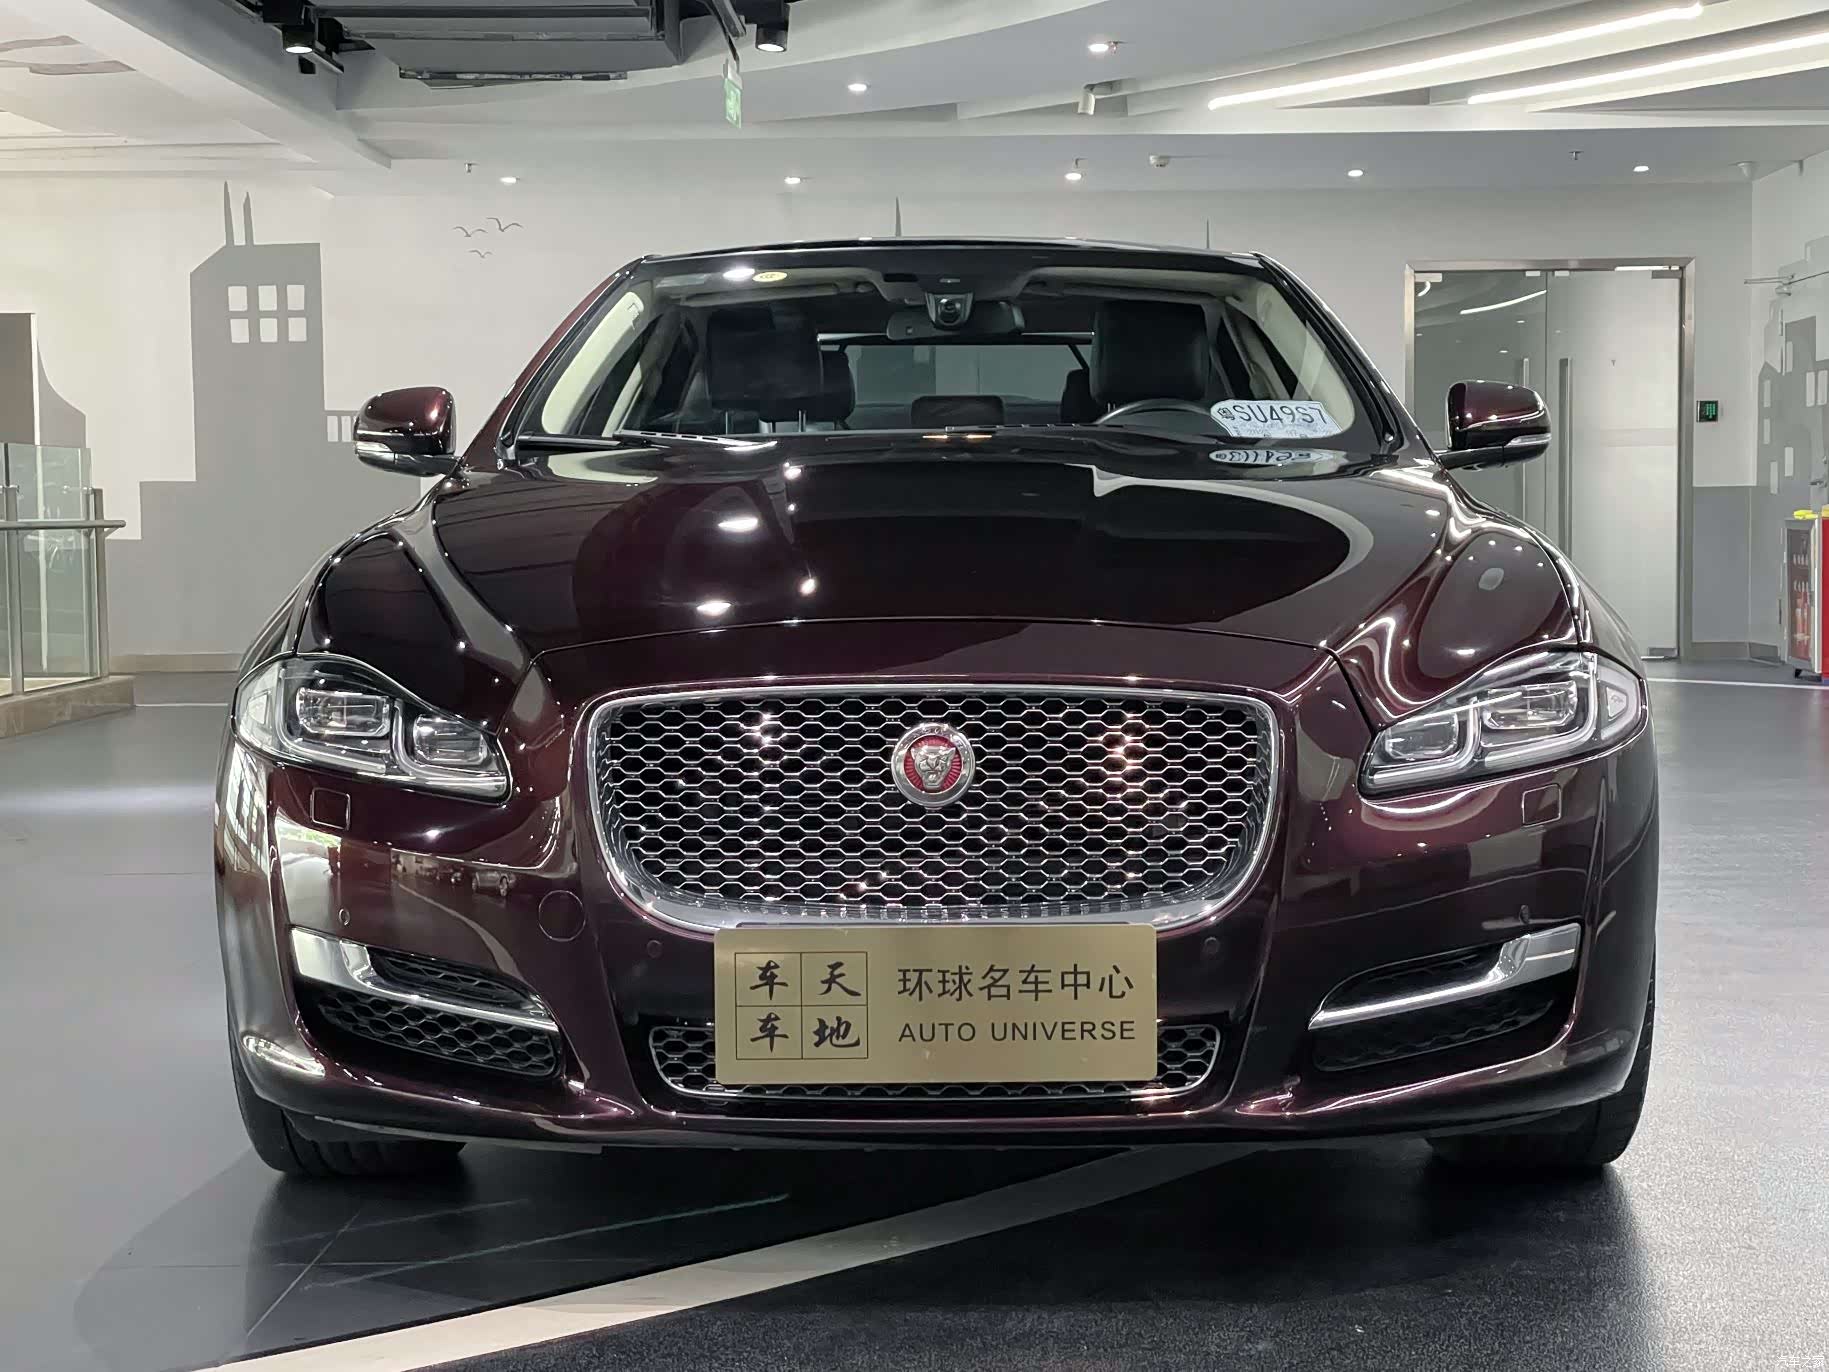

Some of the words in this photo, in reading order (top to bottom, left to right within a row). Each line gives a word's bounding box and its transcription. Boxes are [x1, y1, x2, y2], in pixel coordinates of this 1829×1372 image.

[897, 963, 1135, 1003] 环球名车中心
[898, 1021, 977, 1043] AUTO
[990, 1019, 1136, 1042] UNIVERSE
